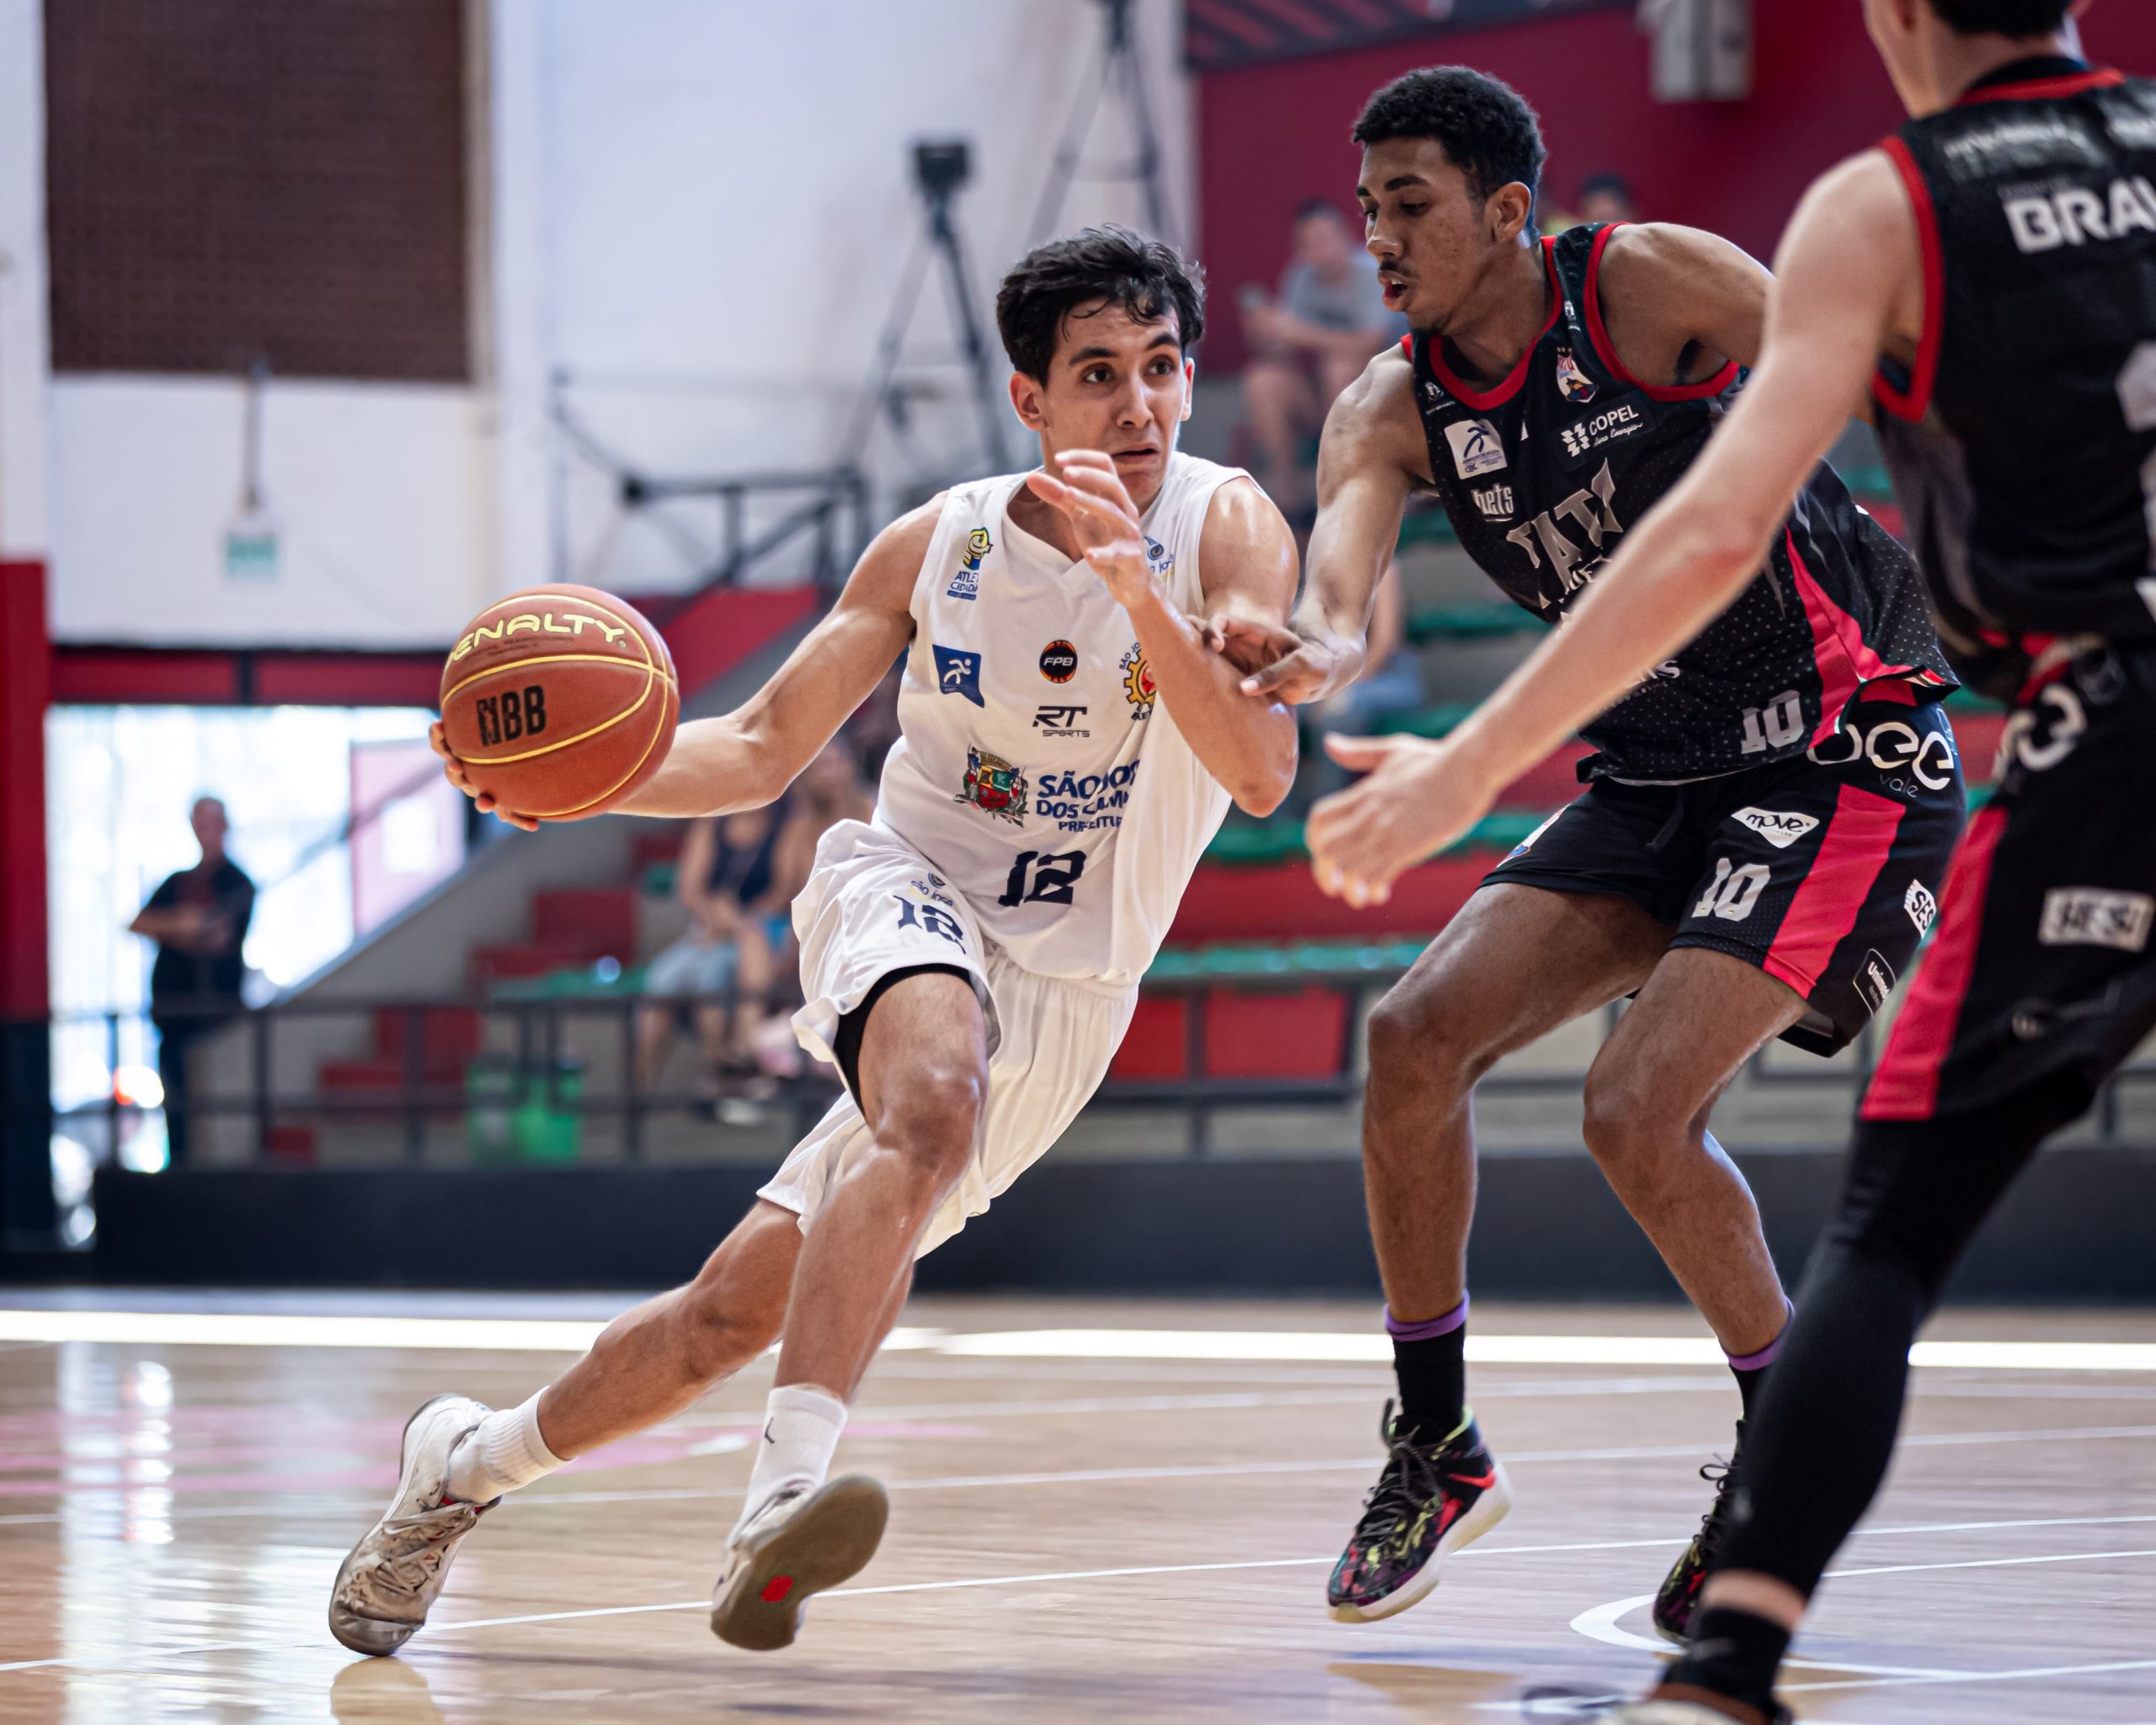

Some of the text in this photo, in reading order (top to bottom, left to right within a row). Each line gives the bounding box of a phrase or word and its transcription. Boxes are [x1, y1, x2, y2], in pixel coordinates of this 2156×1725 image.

[1589, 405, 1639, 435] COPEL
[451, 613, 625, 661] ENALTY
[1043, 657, 1074, 666] FPB
[476, 685, 547, 747] NBB
[1032, 706, 1088, 728] RT
[1741, 691, 1804, 755] 10
[1042, 729, 1090, 738] SPORTS
[1037, 771, 1102, 799] SÃO
[1880, 774, 1919, 798] vale
[1036, 799, 1080, 820] DOS
[1746, 814, 1804, 832] move
[997, 851, 1086, 907] 12
[1692, 857, 1771, 921] 10
[893, 895, 966, 954] 12
